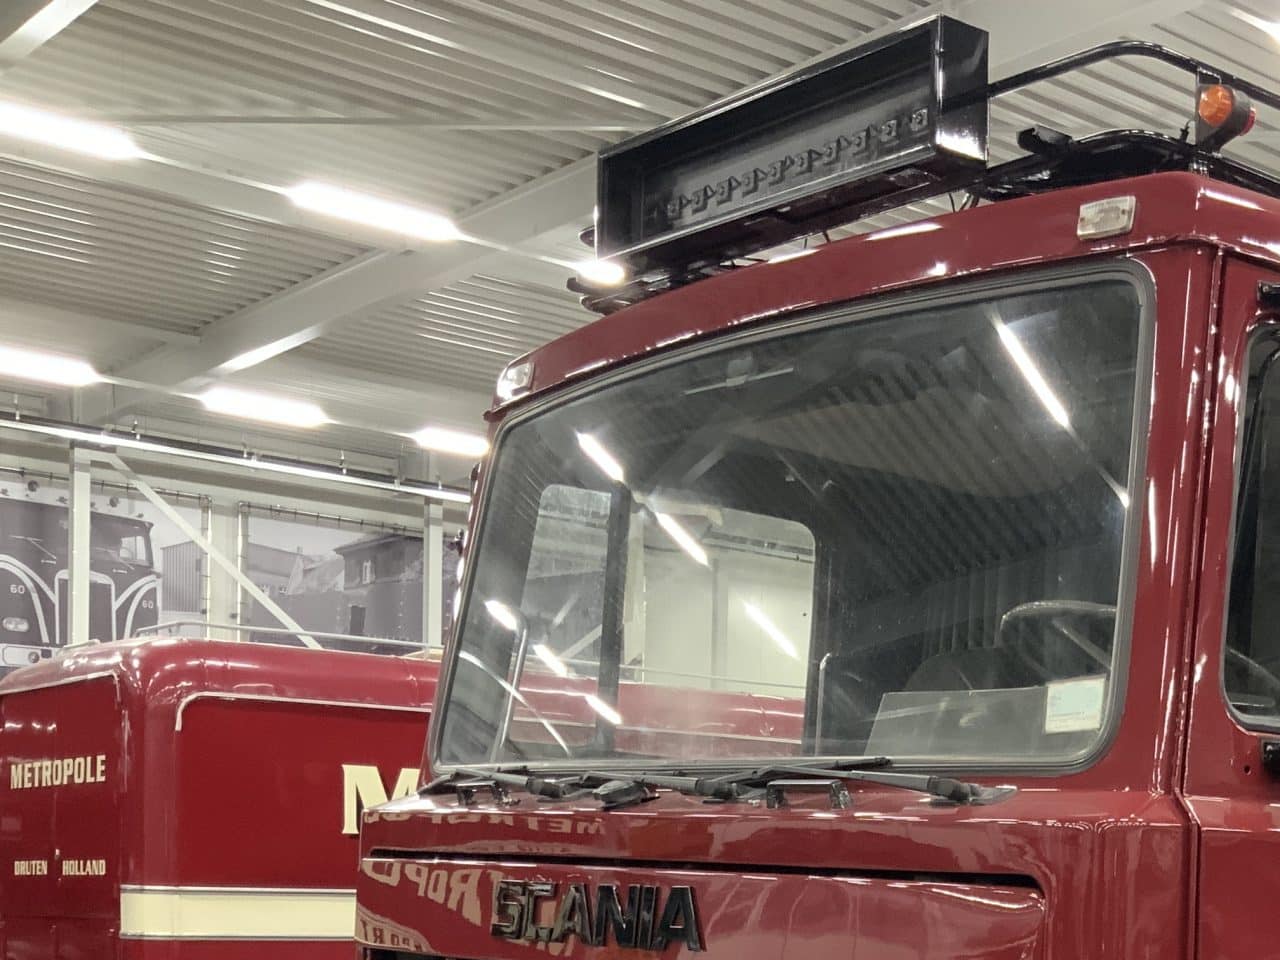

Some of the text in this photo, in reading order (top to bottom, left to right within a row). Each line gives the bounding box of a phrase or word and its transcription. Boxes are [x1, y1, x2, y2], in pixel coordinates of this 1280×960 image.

[10, 584, 26, 595] 60
[142, 600, 154, 609] 60
[10, 754, 107, 790] METROPOLE
[14, 859, 107, 876] DRUTEN HOLLAND
[490, 876, 707, 953] SCANIA
